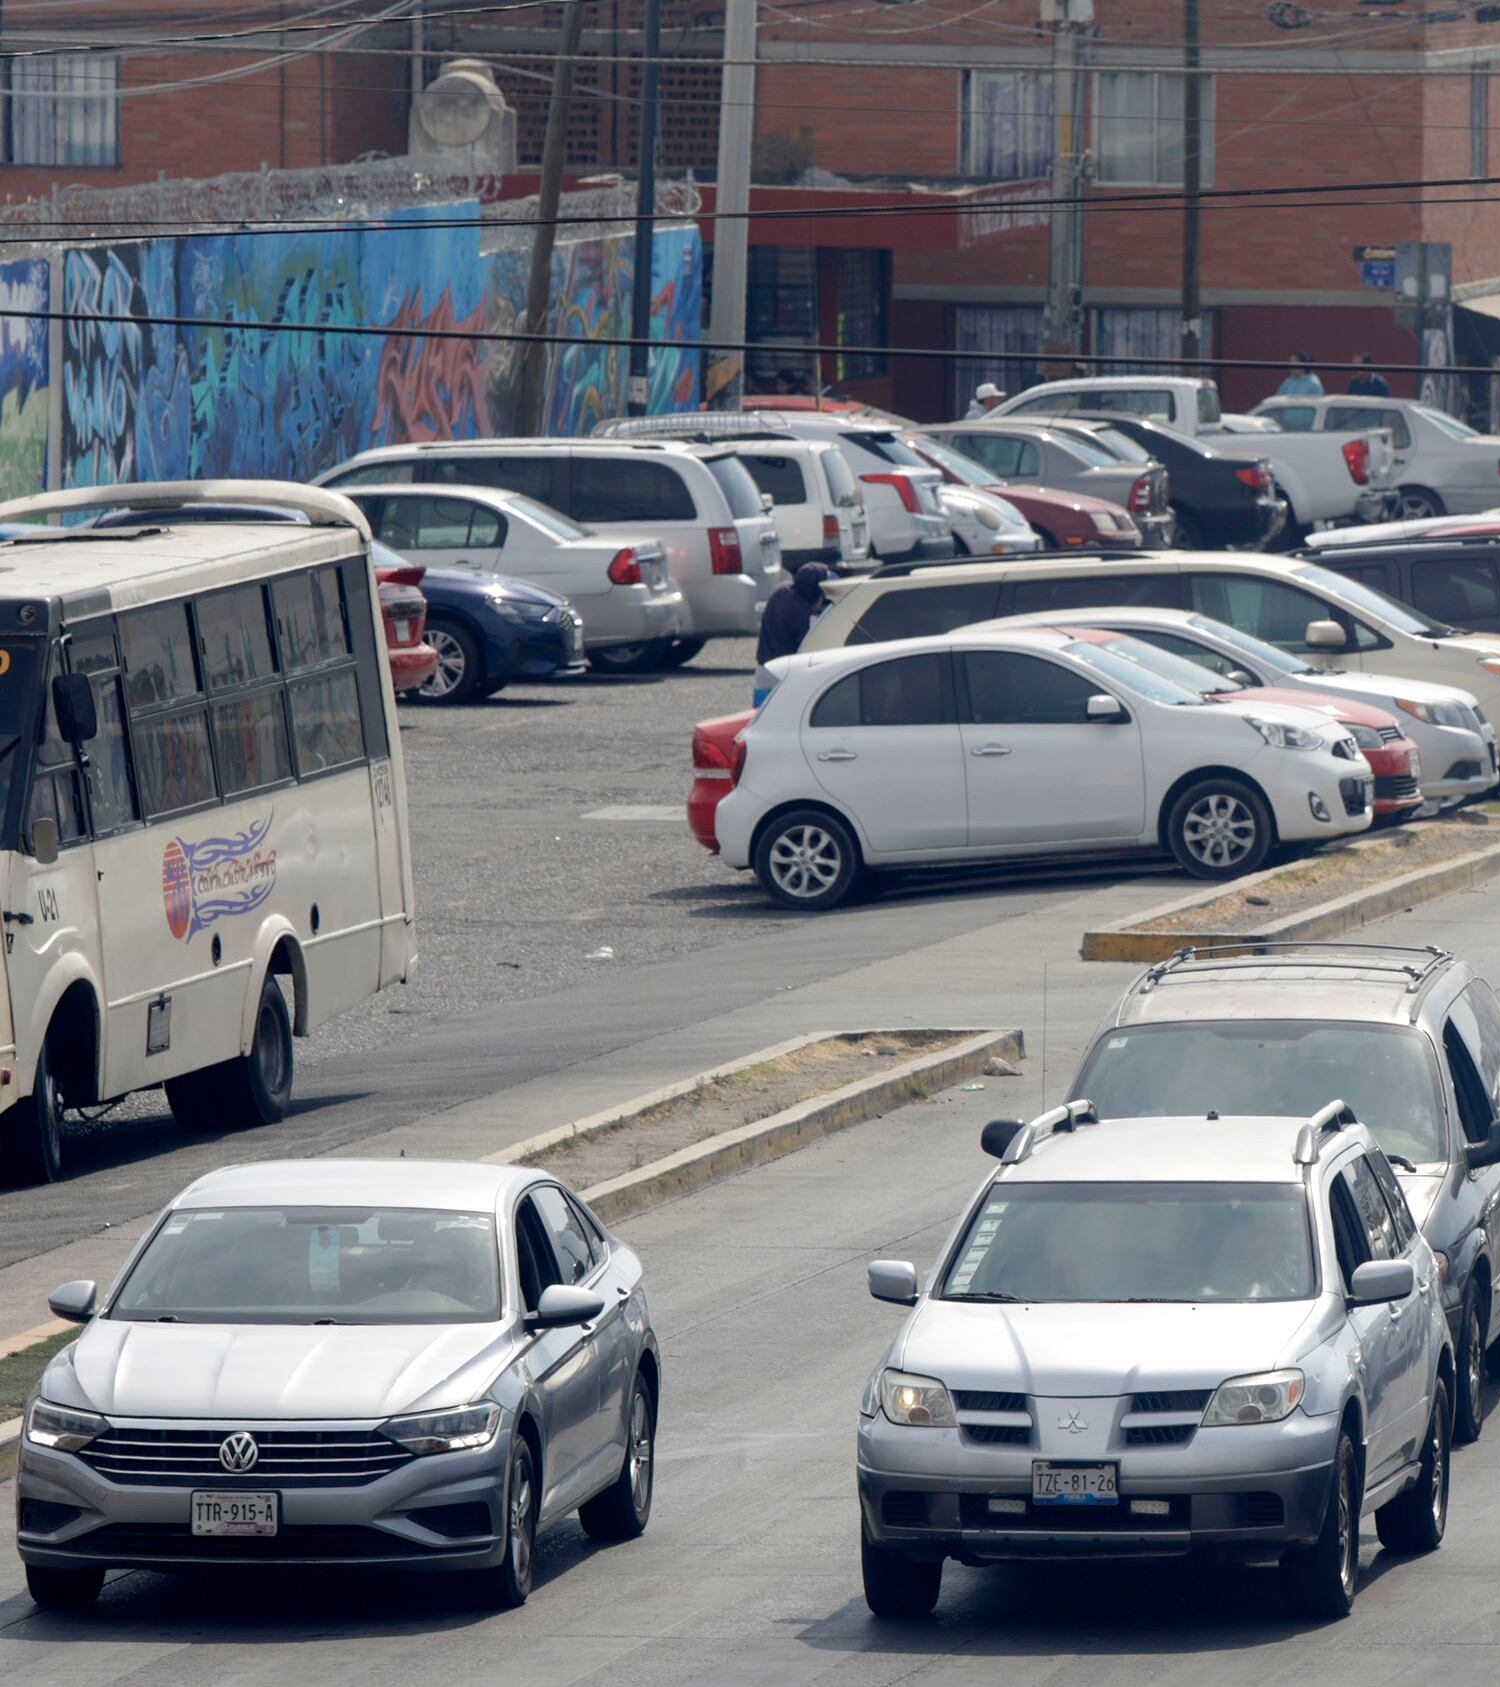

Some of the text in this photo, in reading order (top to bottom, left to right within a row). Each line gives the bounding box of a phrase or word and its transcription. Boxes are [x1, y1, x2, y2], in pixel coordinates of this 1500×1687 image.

[37, 888, 60, 922] U-21
[1035, 1473, 1114, 1493] TZE-81-26
[196, 1502, 274, 1522] TTR-915-A
